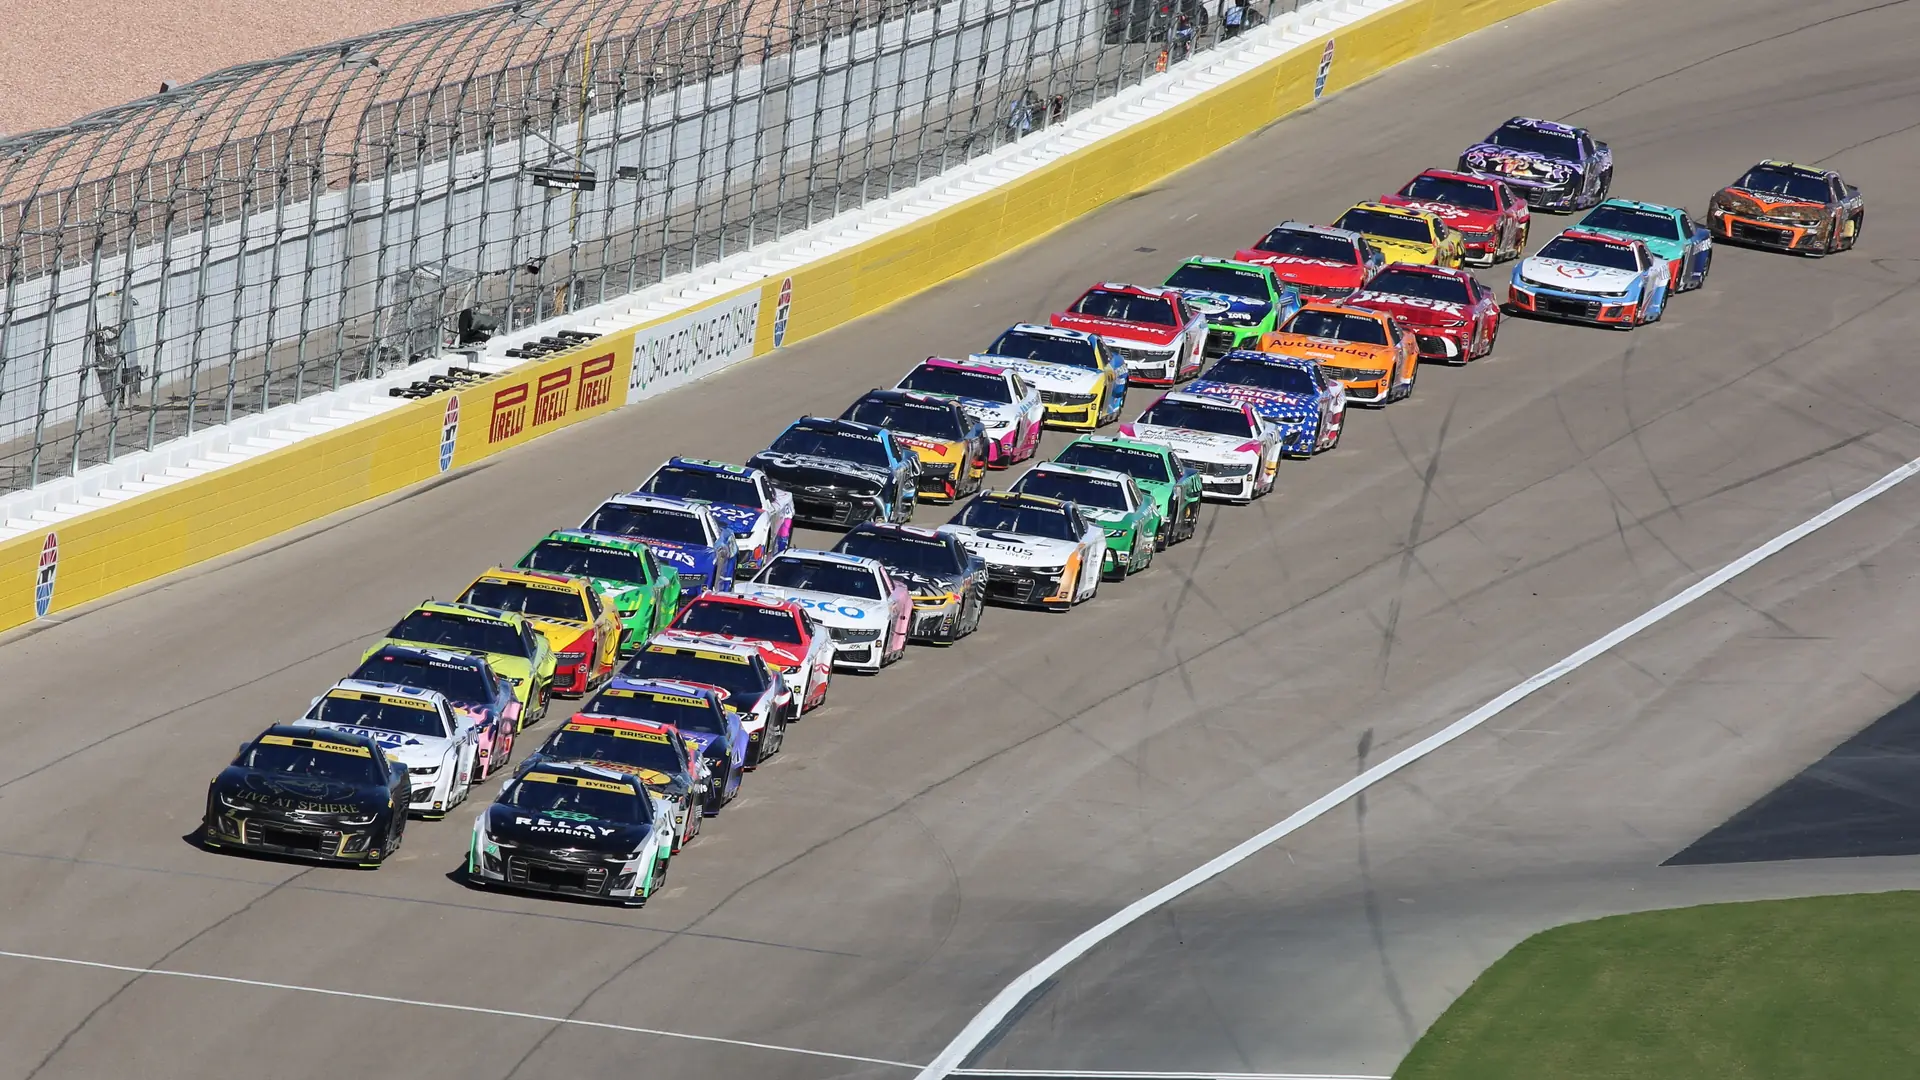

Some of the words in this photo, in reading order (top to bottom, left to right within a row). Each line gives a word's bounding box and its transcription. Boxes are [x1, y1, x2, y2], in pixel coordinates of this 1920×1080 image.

[1635, 211, 1673, 221] MCDOWELL
[1320, 235, 1347, 243] CUSTER
[1605, 244, 1630, 252] HALEY
[1269, 340, 1378, 360] Autotrader
[576, 352, 615, 411] PIRELLI
[532, 367, 571, 427] PIRELLI
[1202, 387, 1298, 405] AMERICAN
[1230, 395, 1267, 406] BEER
[904, 402, 940, 411] GRAGSON
[1202, 405, 1240, 414] KESELOWSK
[489, 383, 528, 443] PIRELLI
[1127, 449, 1160, 459] DILLON
[1088, 479, 1118, 488] JONES
[589, 547, 631, 557] BOWMAN
[963, 541, 1033, 557] CELSIUS
[836, 564, 868, 573] PREECE
[532, 583, 572, 593] LOGANO
[759, 608, 788, 617] GIBBS
[466, 616, 509, 627] WALLACE
[719, 654, 743, 663] BELL
[429, 661, 470, 672] REDDICK
[387, 697, 428, 708] ELLIOTT
[662, 695, 703, 705] HAMLIN
[338, 726, 401, 744] NAPA
[619, 730, 664, 741] BRISCOE
[318, 743, 360, 754] LARSON
[586, 781, 621, 791] BYRON
[236, 789, 271, 803] LIVE
[272, 798, 295, 808] AT
[298, 800, 360, 813] SPHERE
[515, 816, 616, 837] RELAY
[530, 826, 597, 840] PAYMENTS
